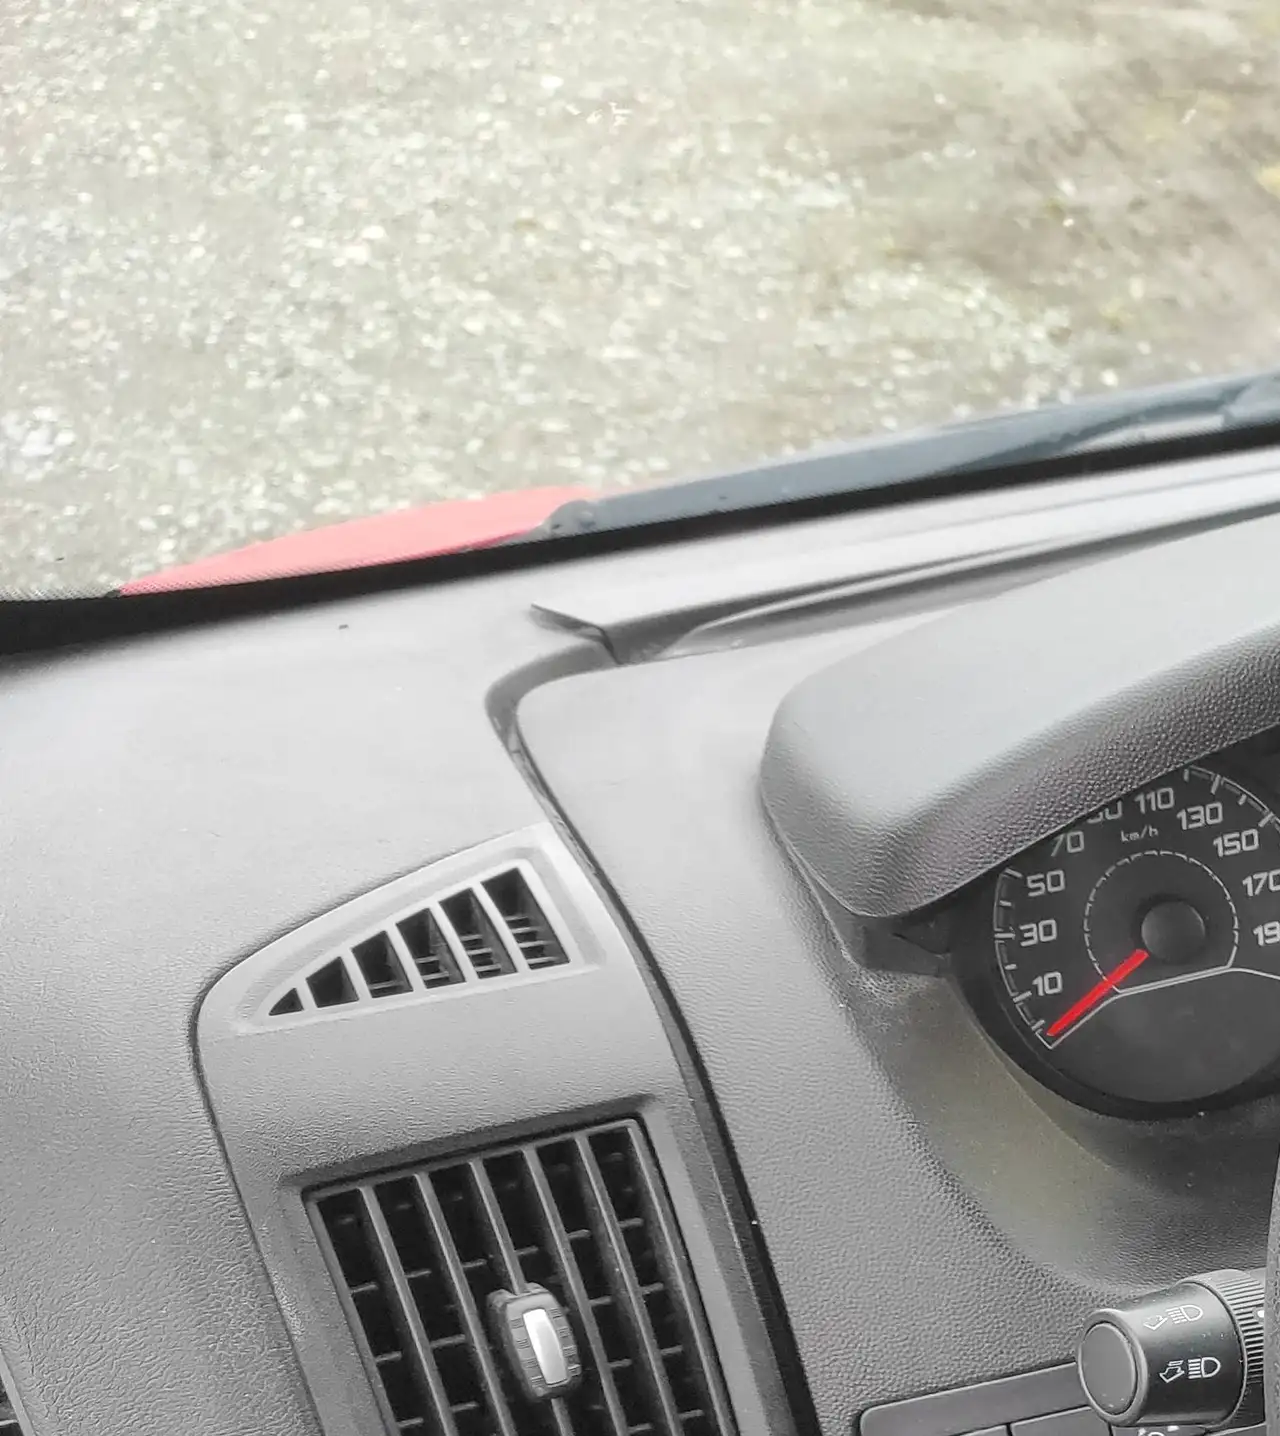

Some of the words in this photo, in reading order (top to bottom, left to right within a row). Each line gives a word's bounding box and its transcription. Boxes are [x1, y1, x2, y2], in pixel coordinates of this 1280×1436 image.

[1134, 787, 1175, 814] 110
[1176, 801, 1224, 831] 130
[1120, 824, 1159, 842] km/h
[1212, 828, 1260, 858] 150
[1026, 869, 1066, 897] 50
[1019, 918, 1058, 946] 30
[1032, 971, 1063, 997] 10
